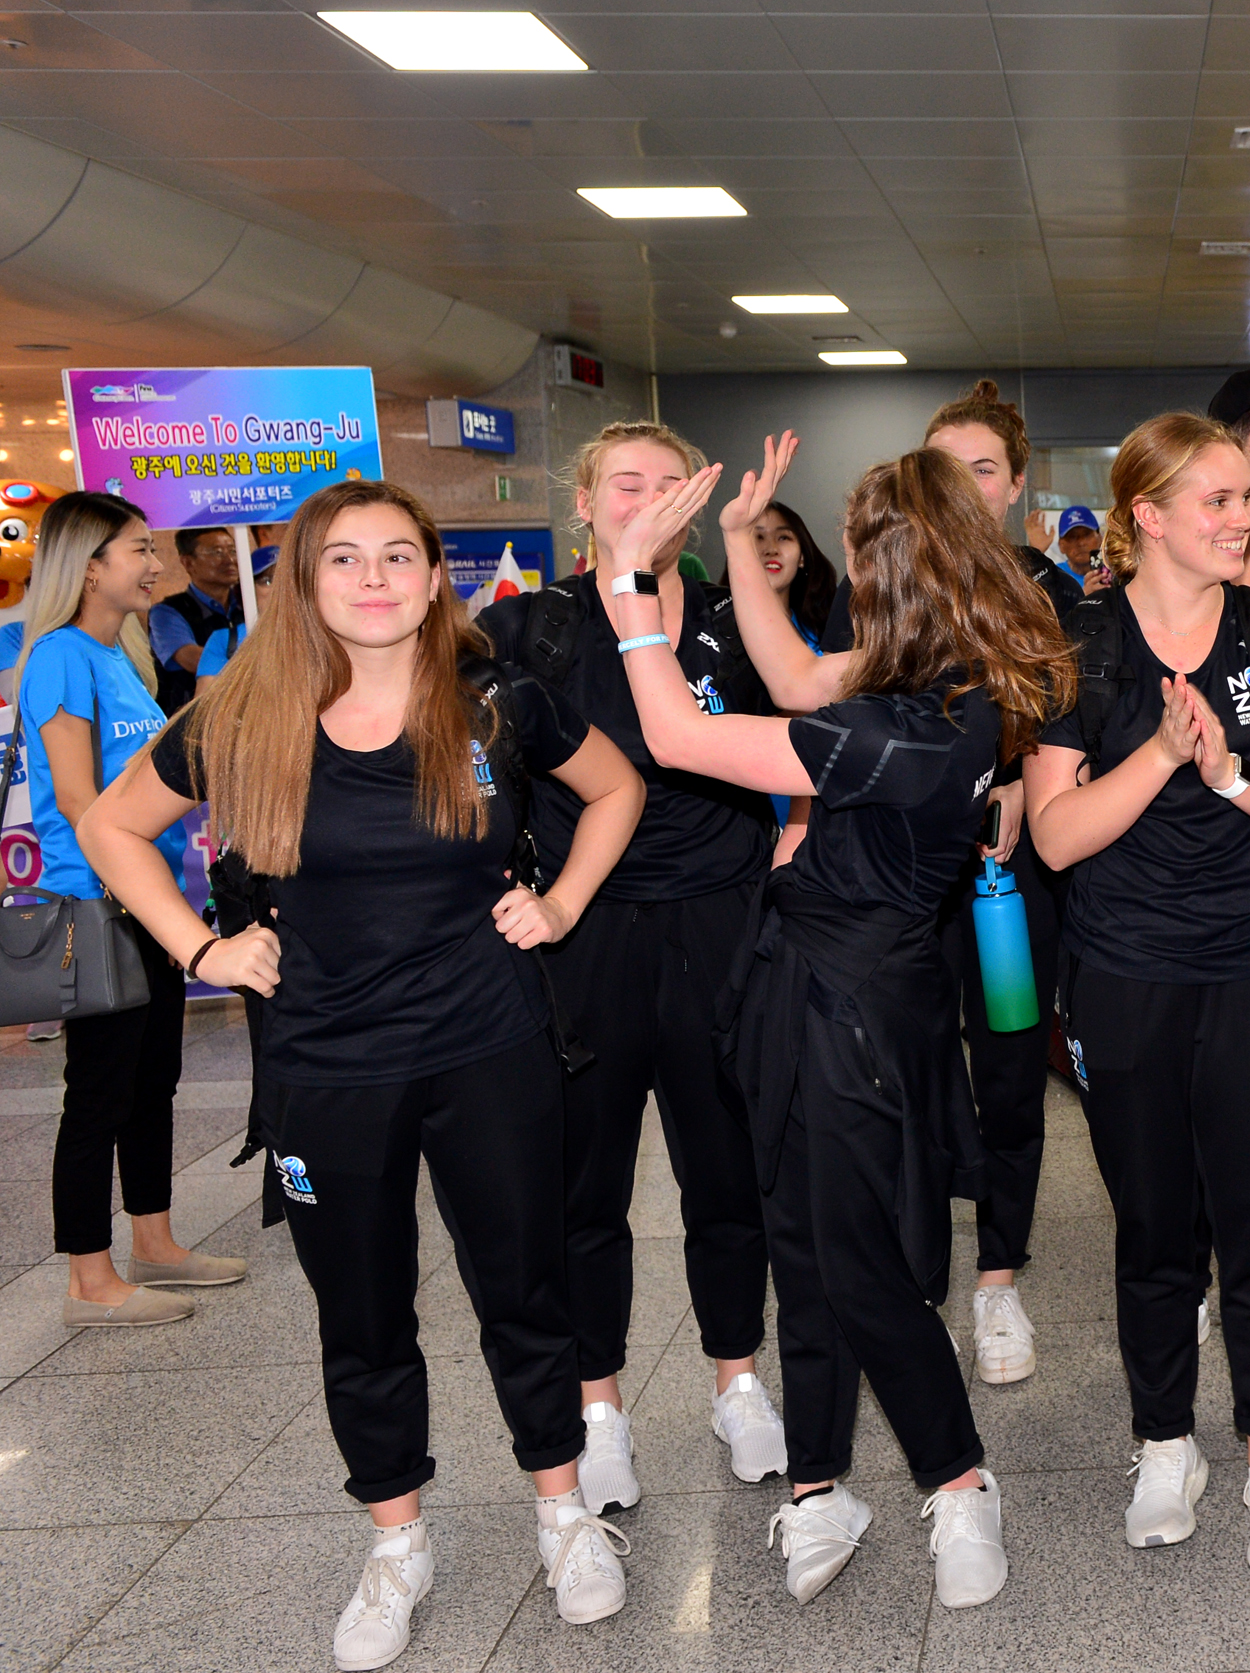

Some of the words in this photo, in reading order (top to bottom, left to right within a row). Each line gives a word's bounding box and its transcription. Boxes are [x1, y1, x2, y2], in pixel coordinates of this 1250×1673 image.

[92, 417, 205, 449] Welcome
[208, 414, 239, 446] To
[244, 411, 361, 446] Gwang-Ju
[130, 455, 182, 480] 광주에
[186, 453, 218, 477] 오신
[220, 452, 252, 476] 것을
[255, 449, 336, 475] 환영합니다!
[189, 485, 293, 506] 광주시민서포터즈
[645, 635, 662, 643] FOR
